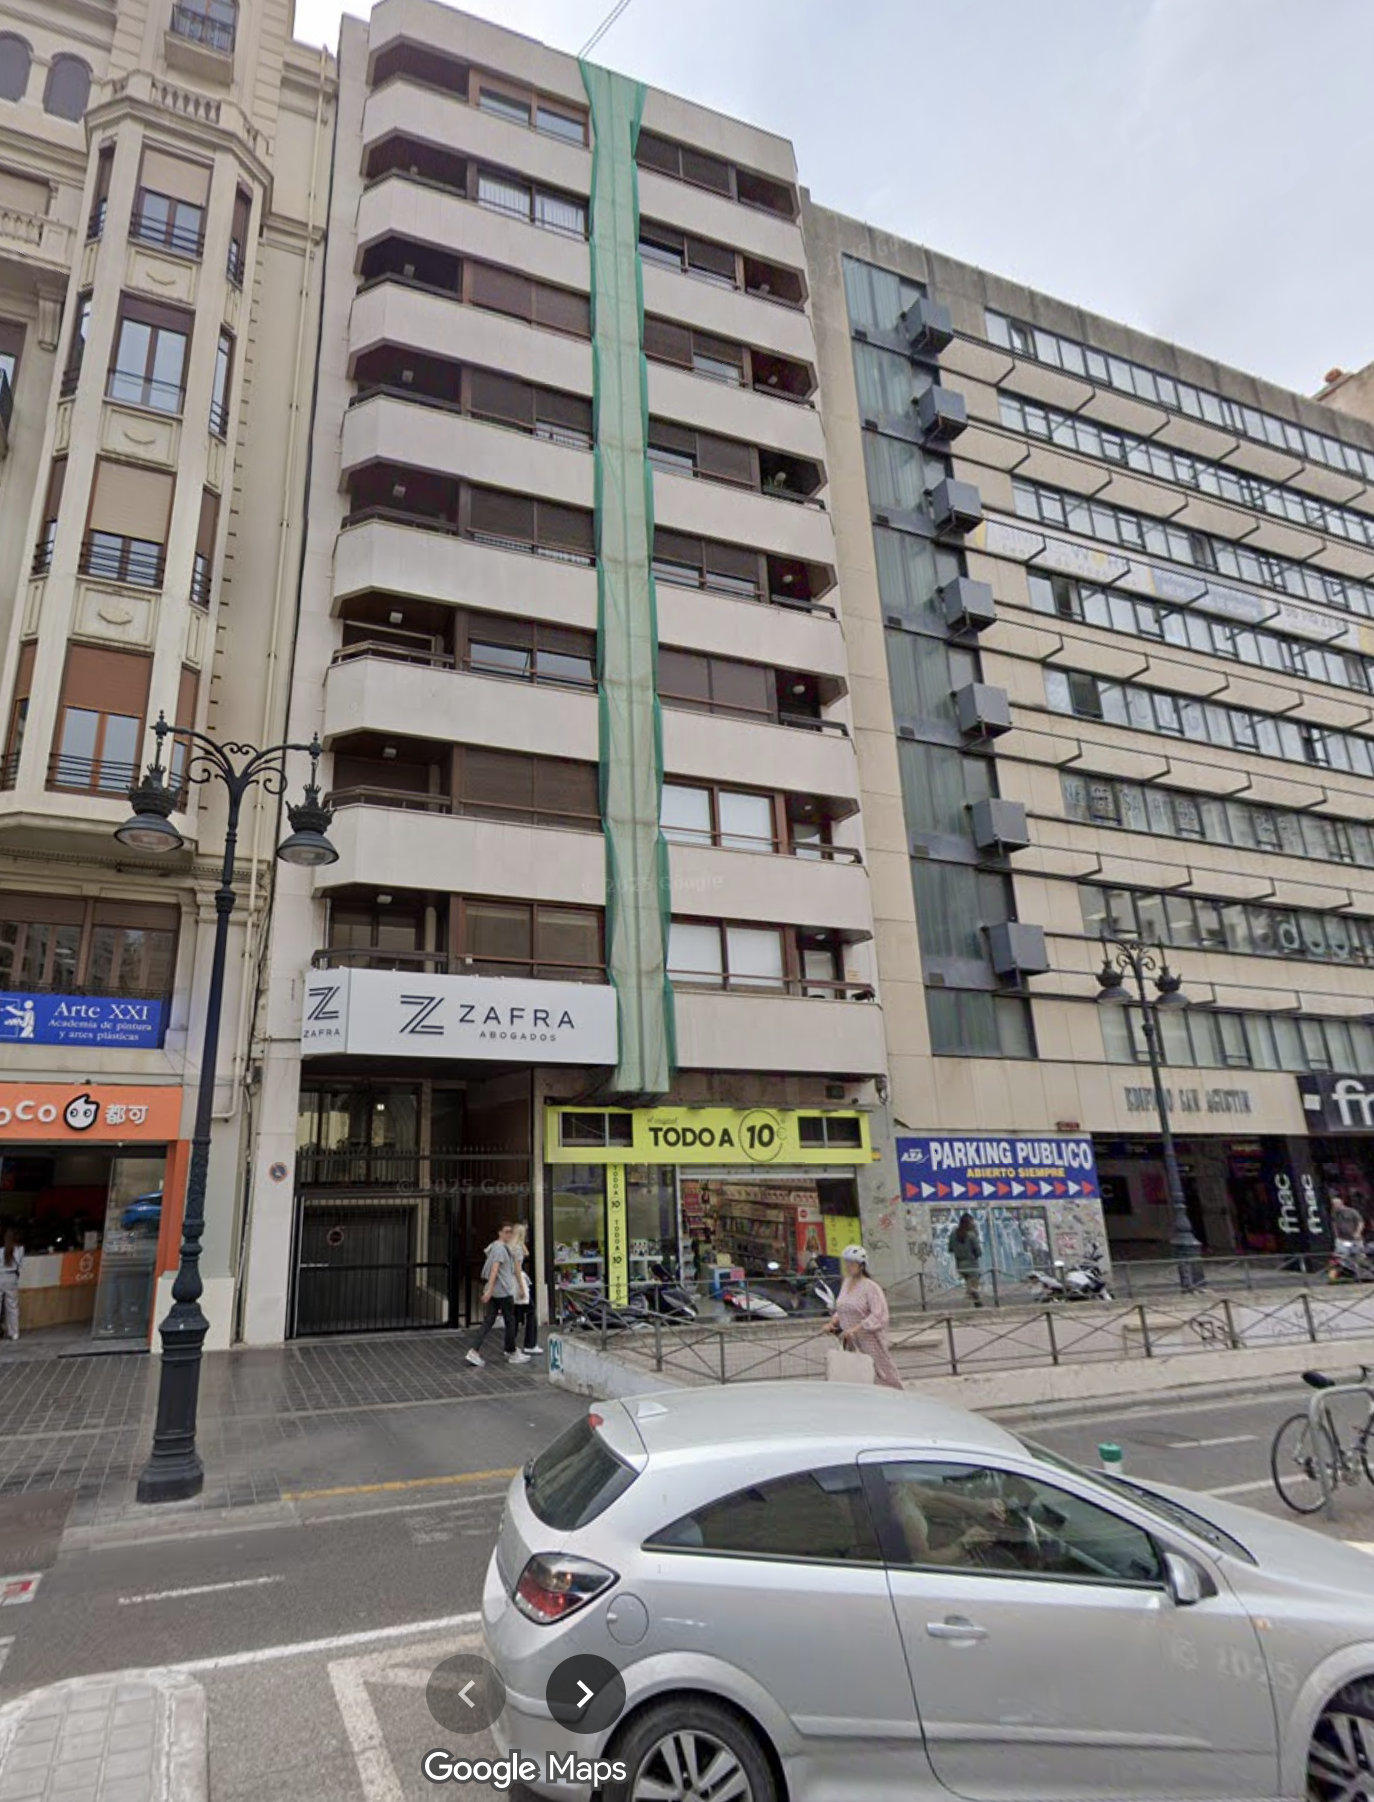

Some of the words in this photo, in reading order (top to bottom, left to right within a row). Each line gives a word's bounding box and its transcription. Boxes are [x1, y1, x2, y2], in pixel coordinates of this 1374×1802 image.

[54, 1002, 101, 1018] Arte
[109, 1004, 149, 1020] XXI
[459, 1004, 575, 1030] ZAFRA
[48, 1019, 98, 1029] Academia
[100, 1020, 113, 1029] de
[116, 1021, 152, 1031] pintura
[303, 1028, 341, 1039] ZAFRA
[59, 1030, 66, 1039] y
[68, 1031, 93, 1039] artes
[97, 1029, 139, 1041] plásticas
[479, 1030, 557, 1042] ABOGADOS
[105, 1104, 149, 1125] 都可
[648, 1127, 715, 1147] TODO
[718, 1128, 734, 1147] A
[929, 1141, 1011, 1171] PARKING
[1015, 1142, 1093, 1170] PUBLICO
[966, 1167, 1016, 1178] ABIERTO
[1018, 1167, 1066, 1178] SIEMPRE
[1274, 1174, 1300, 1233] fnac
[1301, 1174, 1323, 1234] fnac
